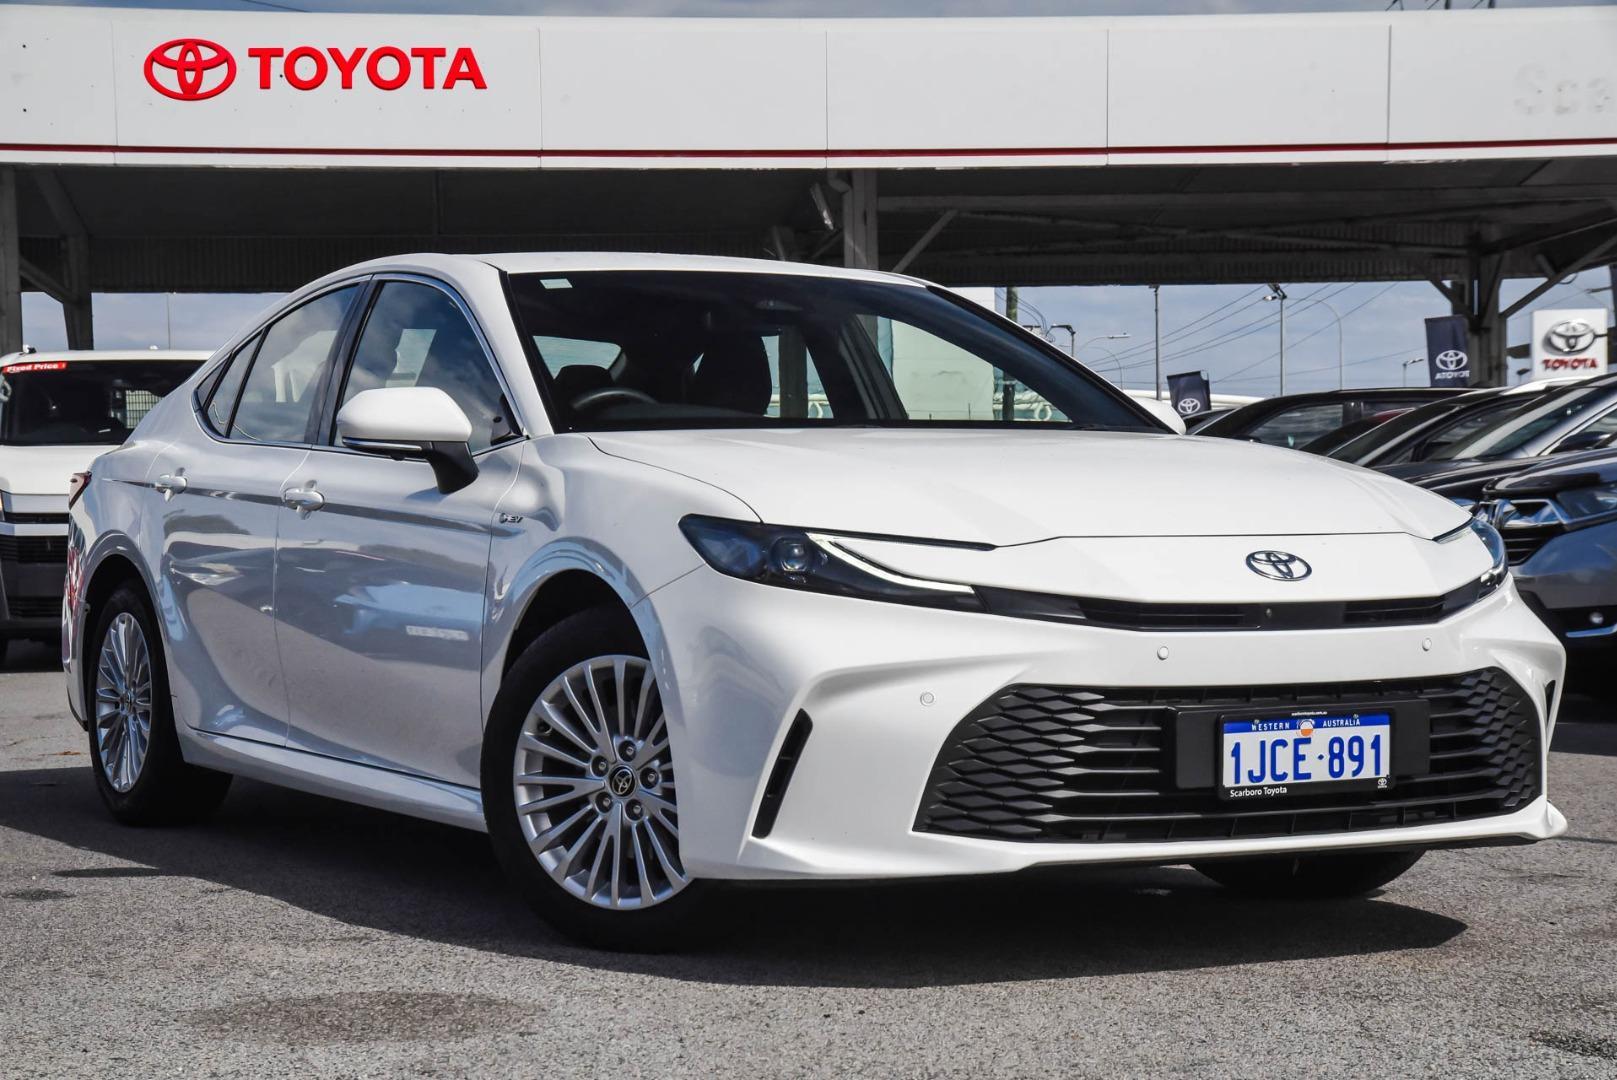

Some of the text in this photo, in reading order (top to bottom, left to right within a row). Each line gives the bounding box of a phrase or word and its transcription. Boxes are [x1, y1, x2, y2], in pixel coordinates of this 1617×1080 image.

[248, 46, 487, 91] TOYOTA
[1542, 359, 1597, 369] TOYOTA
[1251, 718, 1361, 731] WESTERN AUSTRALIA
[1230, 786, 1287, 797] Scarboro Toyota
